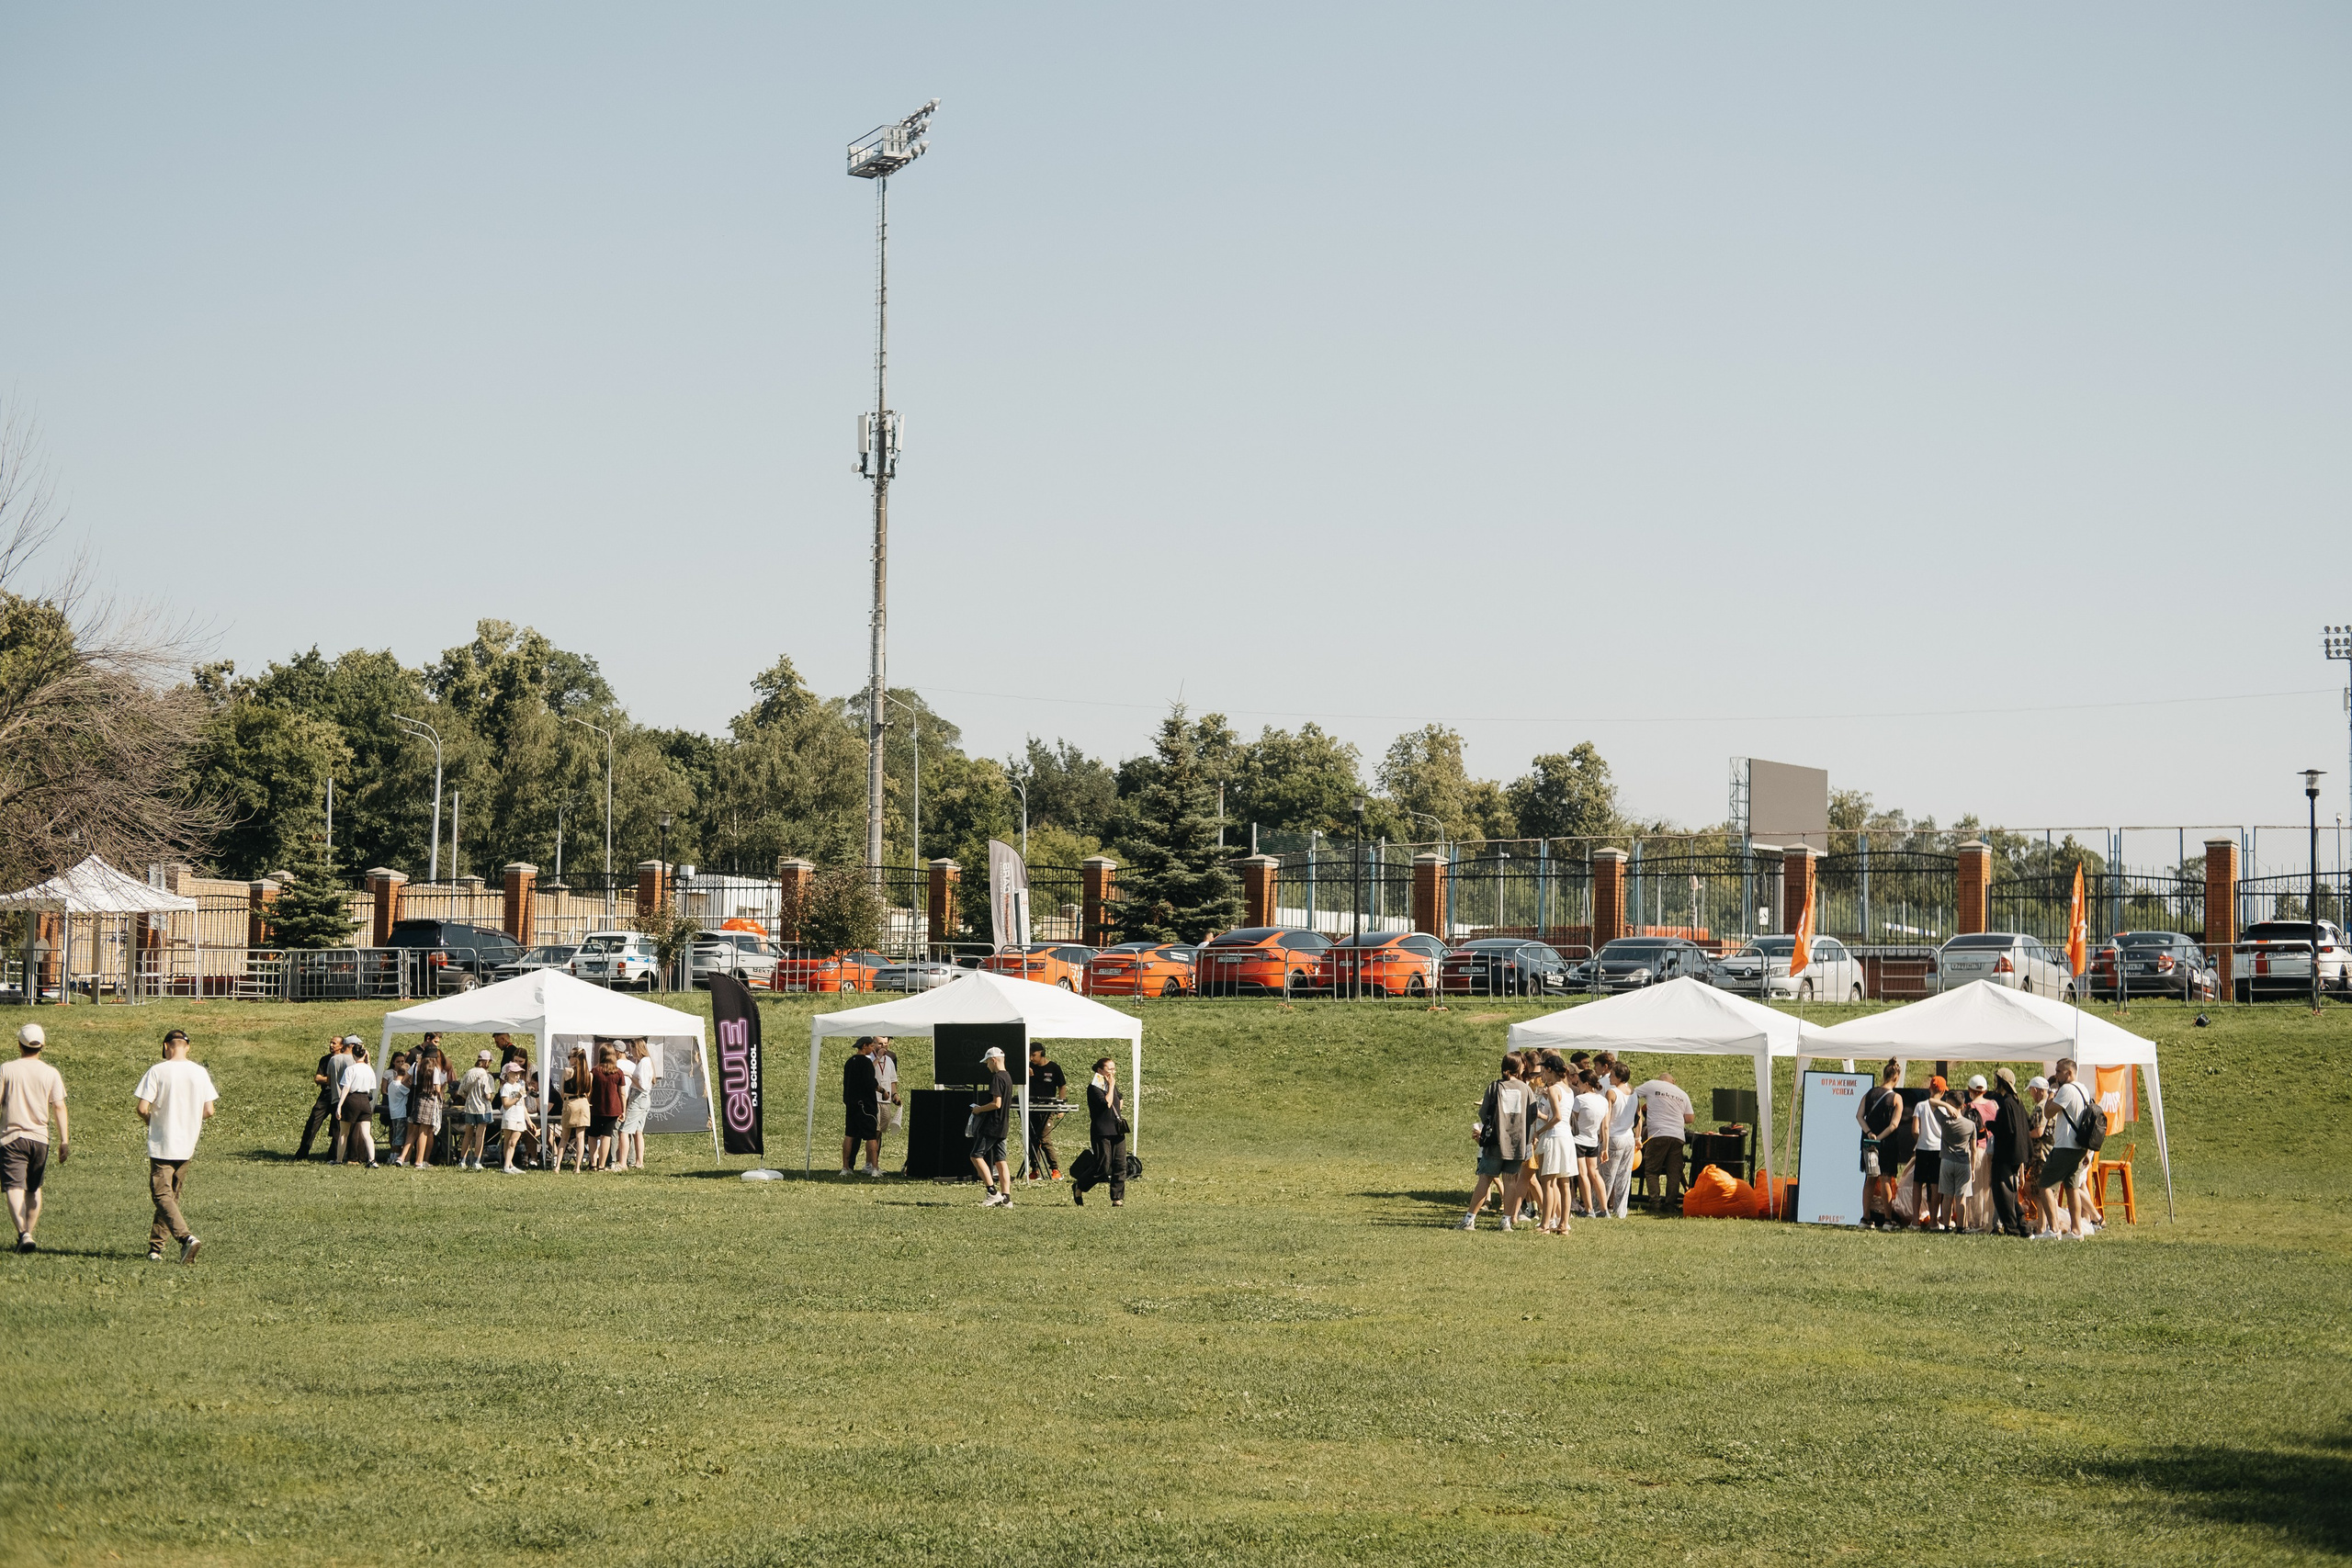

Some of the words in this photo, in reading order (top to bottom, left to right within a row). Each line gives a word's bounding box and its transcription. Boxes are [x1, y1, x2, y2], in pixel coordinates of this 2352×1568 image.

[719, 1018, 753, 1132] CUE
[1821, 1078, 1857, 1088] ОТРАЖЕНИЕ
[1832, 1088, 1854, 1096] УСПЕХА
[752, 1091, 758, 1107] DJ
